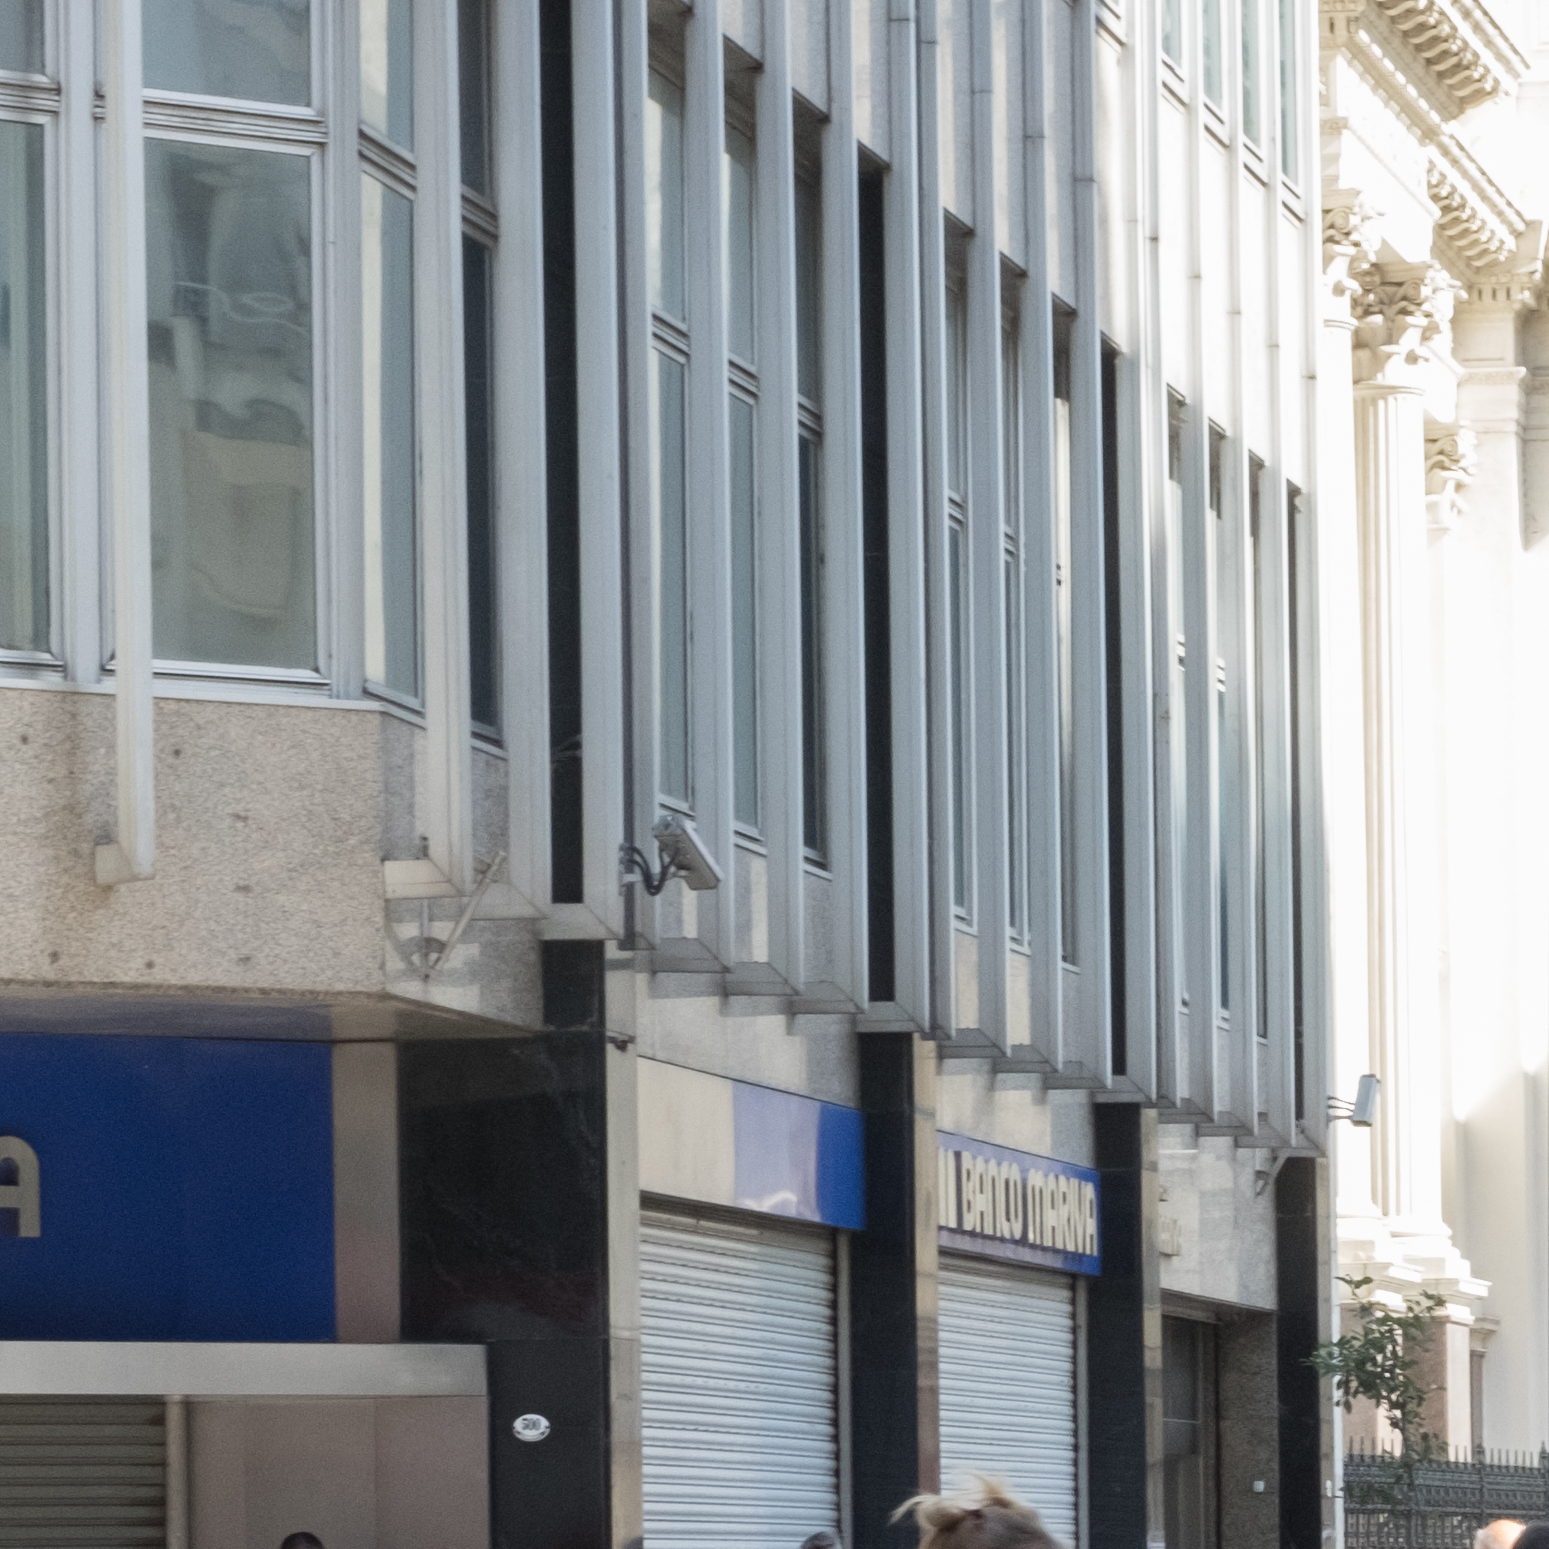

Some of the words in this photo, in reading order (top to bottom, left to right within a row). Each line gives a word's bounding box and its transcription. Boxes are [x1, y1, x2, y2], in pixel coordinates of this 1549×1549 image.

[0, 1136, 41, 1237] A
[962, 1151, 1023, 1240] BANCO
[1027, 1168, 1098, 1257] MARIVA
